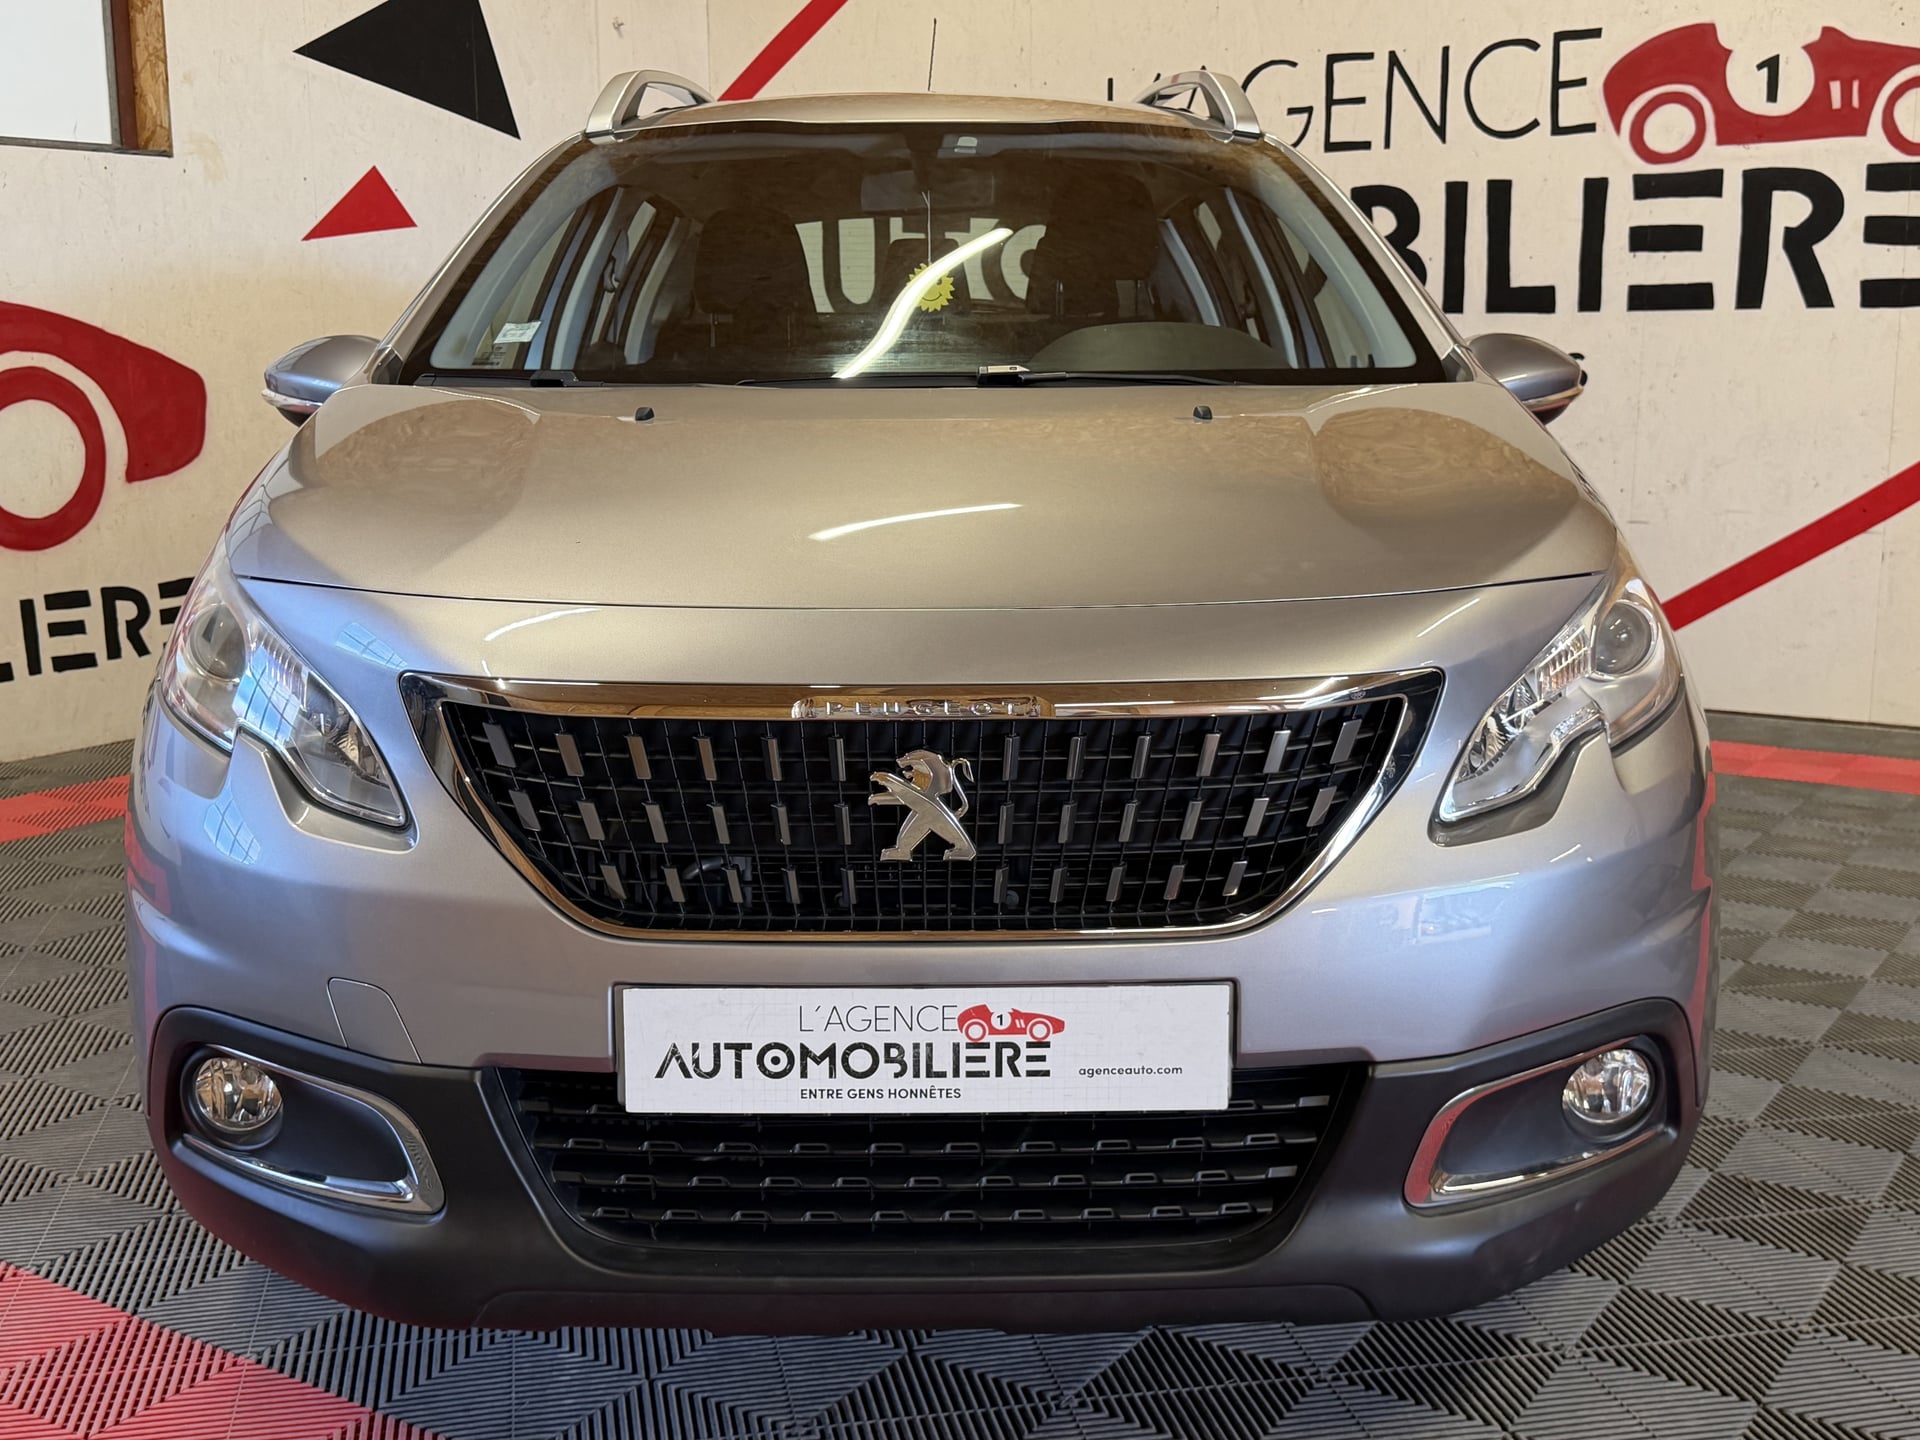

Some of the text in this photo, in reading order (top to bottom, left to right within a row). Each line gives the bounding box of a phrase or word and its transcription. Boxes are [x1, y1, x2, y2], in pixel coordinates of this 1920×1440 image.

[1756, 54, 1780, 103] 1
[1107, 27, 1602, 153] GENCE
[825, 701, 1024, 716] PEUGEOT
[799, 1004, 959, 1033] L'AGENCE
[996, 1014, 1003, 1026] 1
[654, 1041, 1051, 1080] AUTOMOBILIERE
[1078, 1063, 1183, 1078] agenceauto.com
[800, 1085, 962, 1099] ENTRE GENS HONNÊTES
